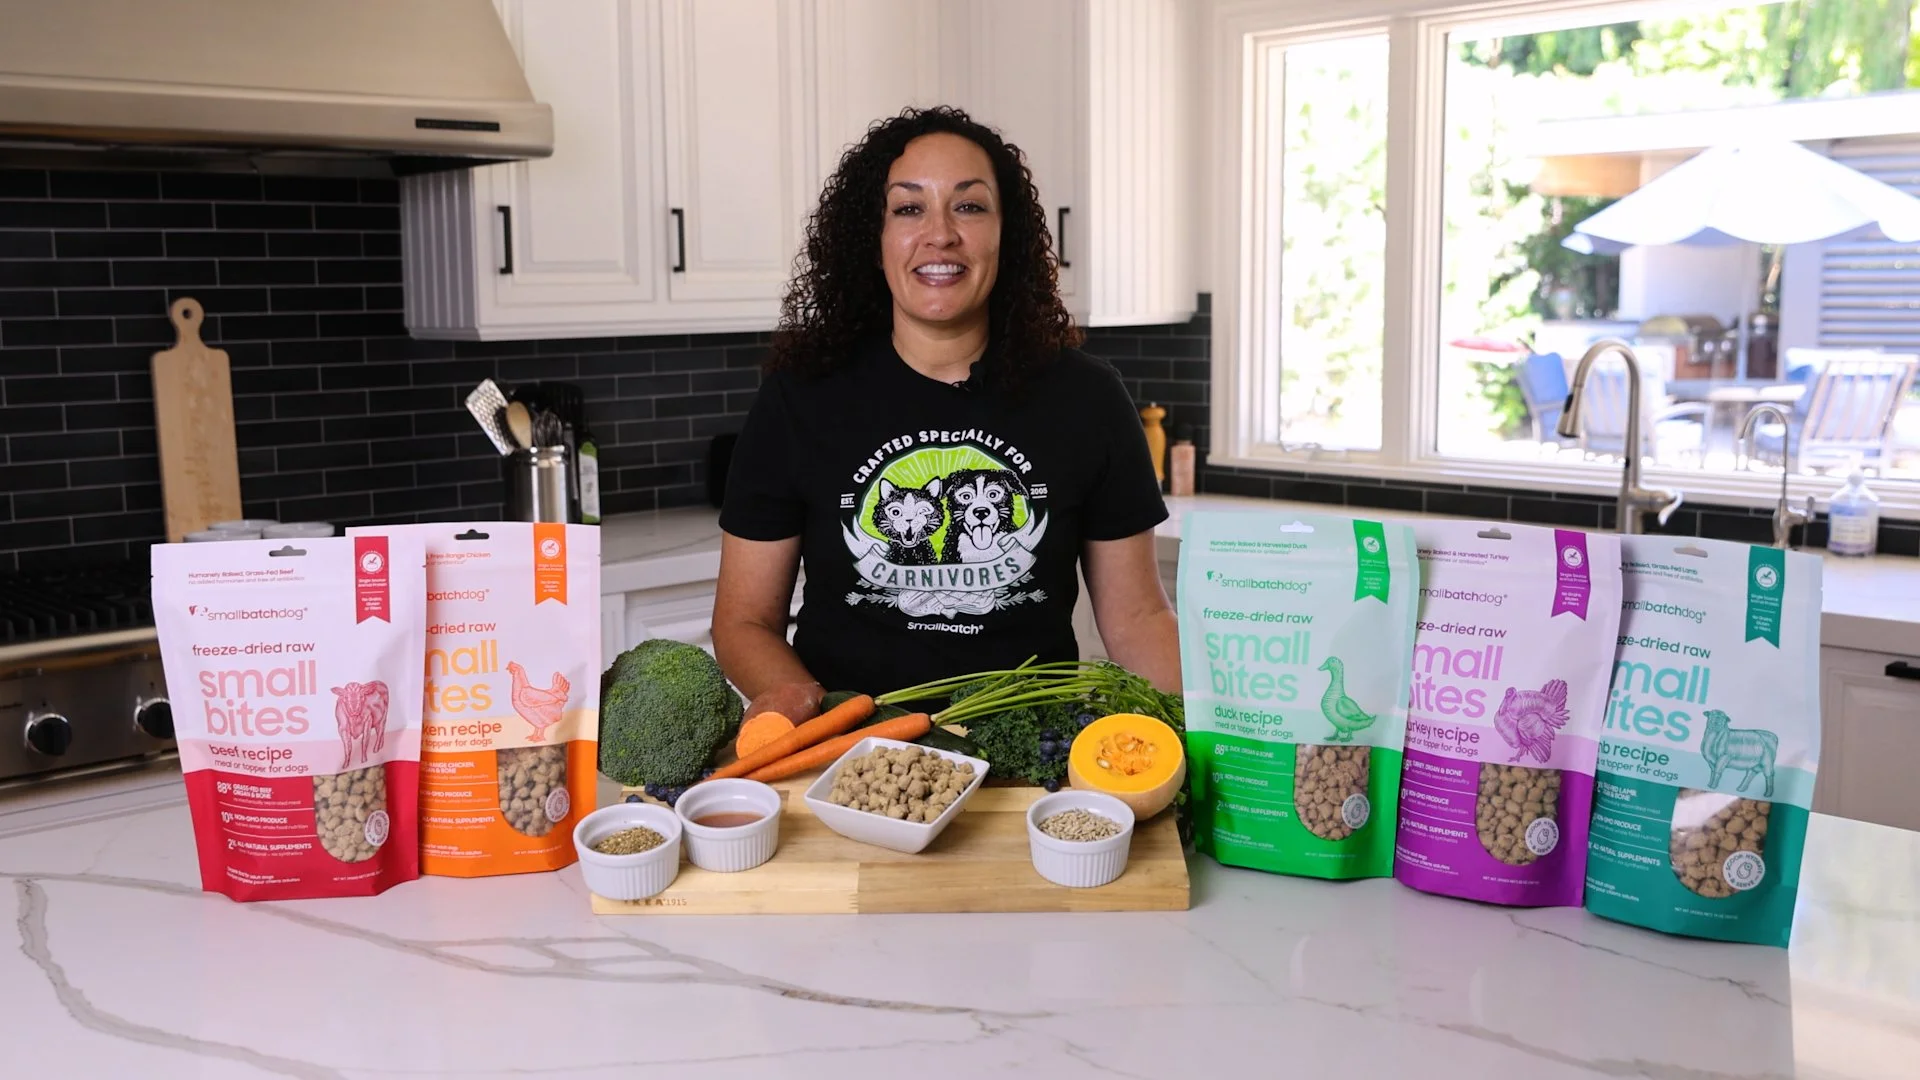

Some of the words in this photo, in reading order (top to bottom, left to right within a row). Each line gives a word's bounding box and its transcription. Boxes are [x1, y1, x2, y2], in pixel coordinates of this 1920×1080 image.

[852, 434, 914, 485] CRAFTED
[918, 428, 1005, 446] SPECIALLY
[1004, 446, 1033, 475] FOR
[1030, 487, 1048, 496] 2005
[1457, 550, 1489, 559] Harvested
[1489, 552, 1510, 561] Turkey
[871, 556, 1022, 587] CARNIVORES
[1682, 566, 1699, 575] Lamb
[1203, 607, 1284, 623] freeze-dried
[1286, 614, 1314, 624] raw
[468, 622, 497, 633] raw
[1478, 626, 1508, 638] raw
[192, 642, 282, 656] freeze-dried
[286, 642, 316, 653] raw
[1204, 630, 1311, 665] small
[1683, 644, 1712, 660] raw
[198, 659, 317, 699] small
[1208, 660, 1299, 703] bites
[203, 698, 310, 737] bites
[1214, 704, 1238, 721] duck
[1239, 710, 1283, 728] recipe
[450, 720, 502, 738] recipe
[1214, 720, 1230, 729] meal
[1237, 723, 1256, 735] topper
[1257, 726, 1269, 737] for
[1270, 727, 1294, 740] dogs
[1433, 725, 1480, 746] recipe
[455, 738, 467, 747] for
[469, 737, 493, 747] dogs
[1423, 739, 1440, 749] topper
[1441, 742, 1453, 752] for
[1455, 745, 1479, 758] dogs
[208, 743, 240, 758] beef
[242, 746, 293, 764] recipe
[1612, 745, 1670, 767] recipe
[215, 759, 232, 768] meal
[233, 761, 241, 769] or
[242, 763, 266, 773] topper
[269, 764, 282, 773] for
[284, 763, 309, 774] dogs
[1445, 767, 1463, 777] BONE
[1635, 763, 1652, 775] for
[1652, 768, 1679, 782] dogs
[1245, 777, 1269, 787] PRODUCE
[1426, 793, 1450, 806] PRODUCE
[260, 816, 288, 824] PRODUCE
[1250, 807, 1289, 818] SUPPLEMENTS
[1428, 824, 1469, 839] SUPPLEMENTS
[1613, 818, 1642, 832] PRODUCE
[269, 842, 313, 851] SUPPLEMENTS
[1617, 850, 1662, 867] SUPPLEMENTS
[1745, 853, 1763, 874] HYDRATE
